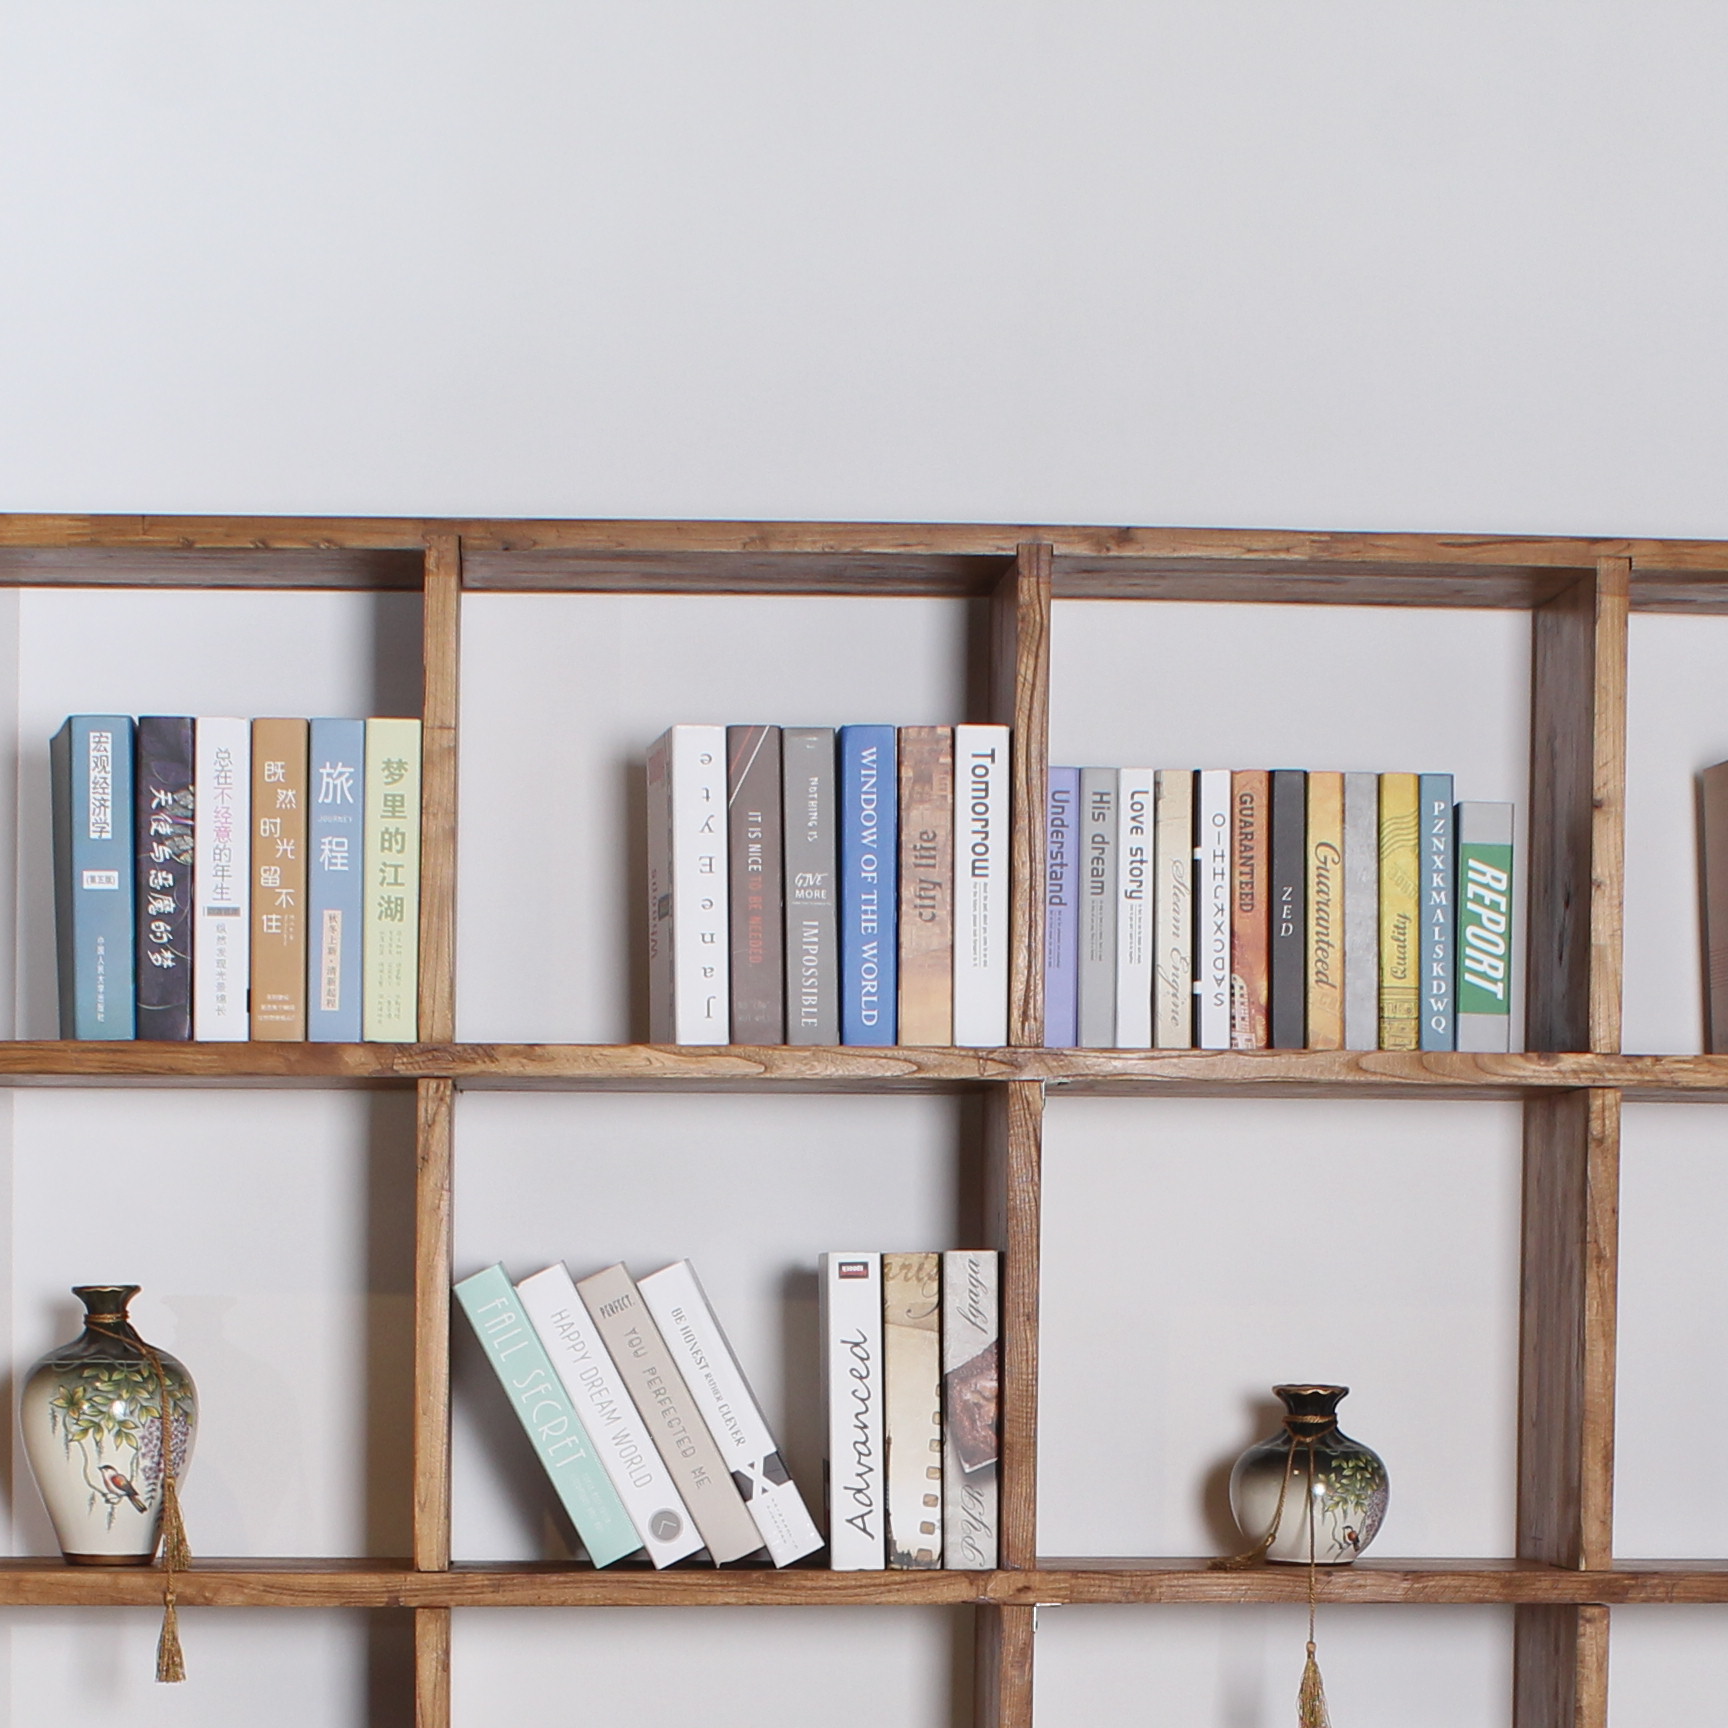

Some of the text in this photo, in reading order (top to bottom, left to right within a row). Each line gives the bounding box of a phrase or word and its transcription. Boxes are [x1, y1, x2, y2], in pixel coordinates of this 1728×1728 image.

[90, 732, 111, 838] 宏观经济学
[747, 811, 763, 824] IT
[807, 776, 819, 843] NOTHING IS
[971, 747, 996, 879] Tomorrow
[1090, 790, 1111, 823] His
[1129, 789, 1150, 836] Love
[259, 761, 297, 934] 既然时光留不住
[377, 758, 409, 923] 梦里的江湖
[747, 827, 763, 840] IS
[747, 843, 763, 873] NICE
[913, 828, 938, 871] life
[1049, 788, 1071, 907] Understand
[1089, 832, 1111, 896] dream
[1237, 792, 1255, 914] GUARANTEED
[748, 876, 763, 891] TO
[748, 895, 763, 911] BE
[795, 889, 827, 900] MORE
[860, 746, 879, 1027] WINDOW OF THE WORLD
[1123, 844, 1150, 901] story
[1280, 886, 1294, 938] ZED
[1314, 841, 1341, 989] Guaranteed
[1464, 857, 1509, 1000] REPORT
[801, 919, 820, 1028] IMPOSSIBLE
[1388, 912, 1411, 981] Quality
[671, 1306, 687, 1327] BE
[478, 1297, 586, 1468] FALL SECRET
[677, 1326, 710, 1376] HONEST
[550, 1308, 593, 1365] HAPPY
[579, 1365, 624, 1428] DREAM
[611, 1427, 654, 1489] WORLD
[623, 1327, 646, 1359] YOU
[690, 1465, 712, 1490] ME
[718, 1402, 746, 1448] CLEVER
[844, 1328, 874, 1541] Advanced
